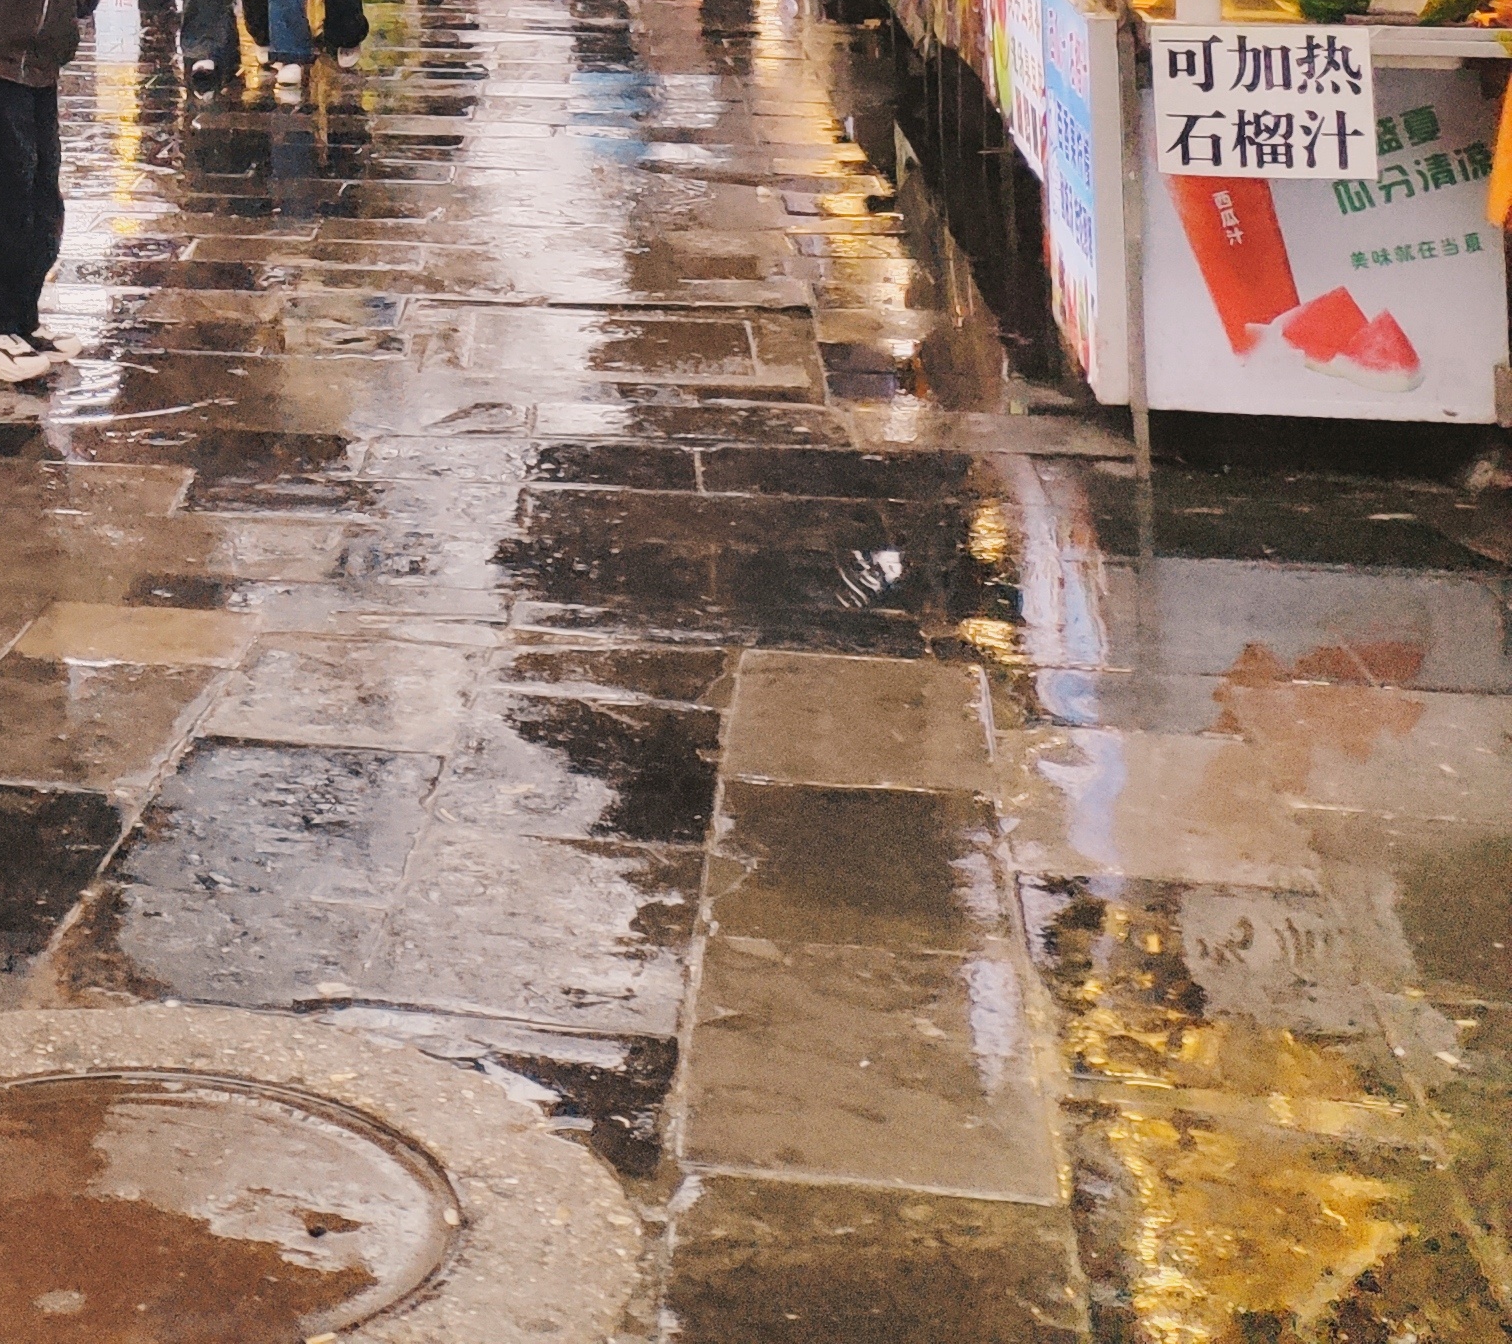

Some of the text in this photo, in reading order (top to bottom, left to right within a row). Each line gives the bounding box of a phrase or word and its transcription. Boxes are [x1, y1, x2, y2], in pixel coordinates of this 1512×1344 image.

[1159, 35, 1362, 96] 可加热
[1165, 109, 1365, 170] 石榴汁
[1213, 190, 1245, 246] 西瓜汁
